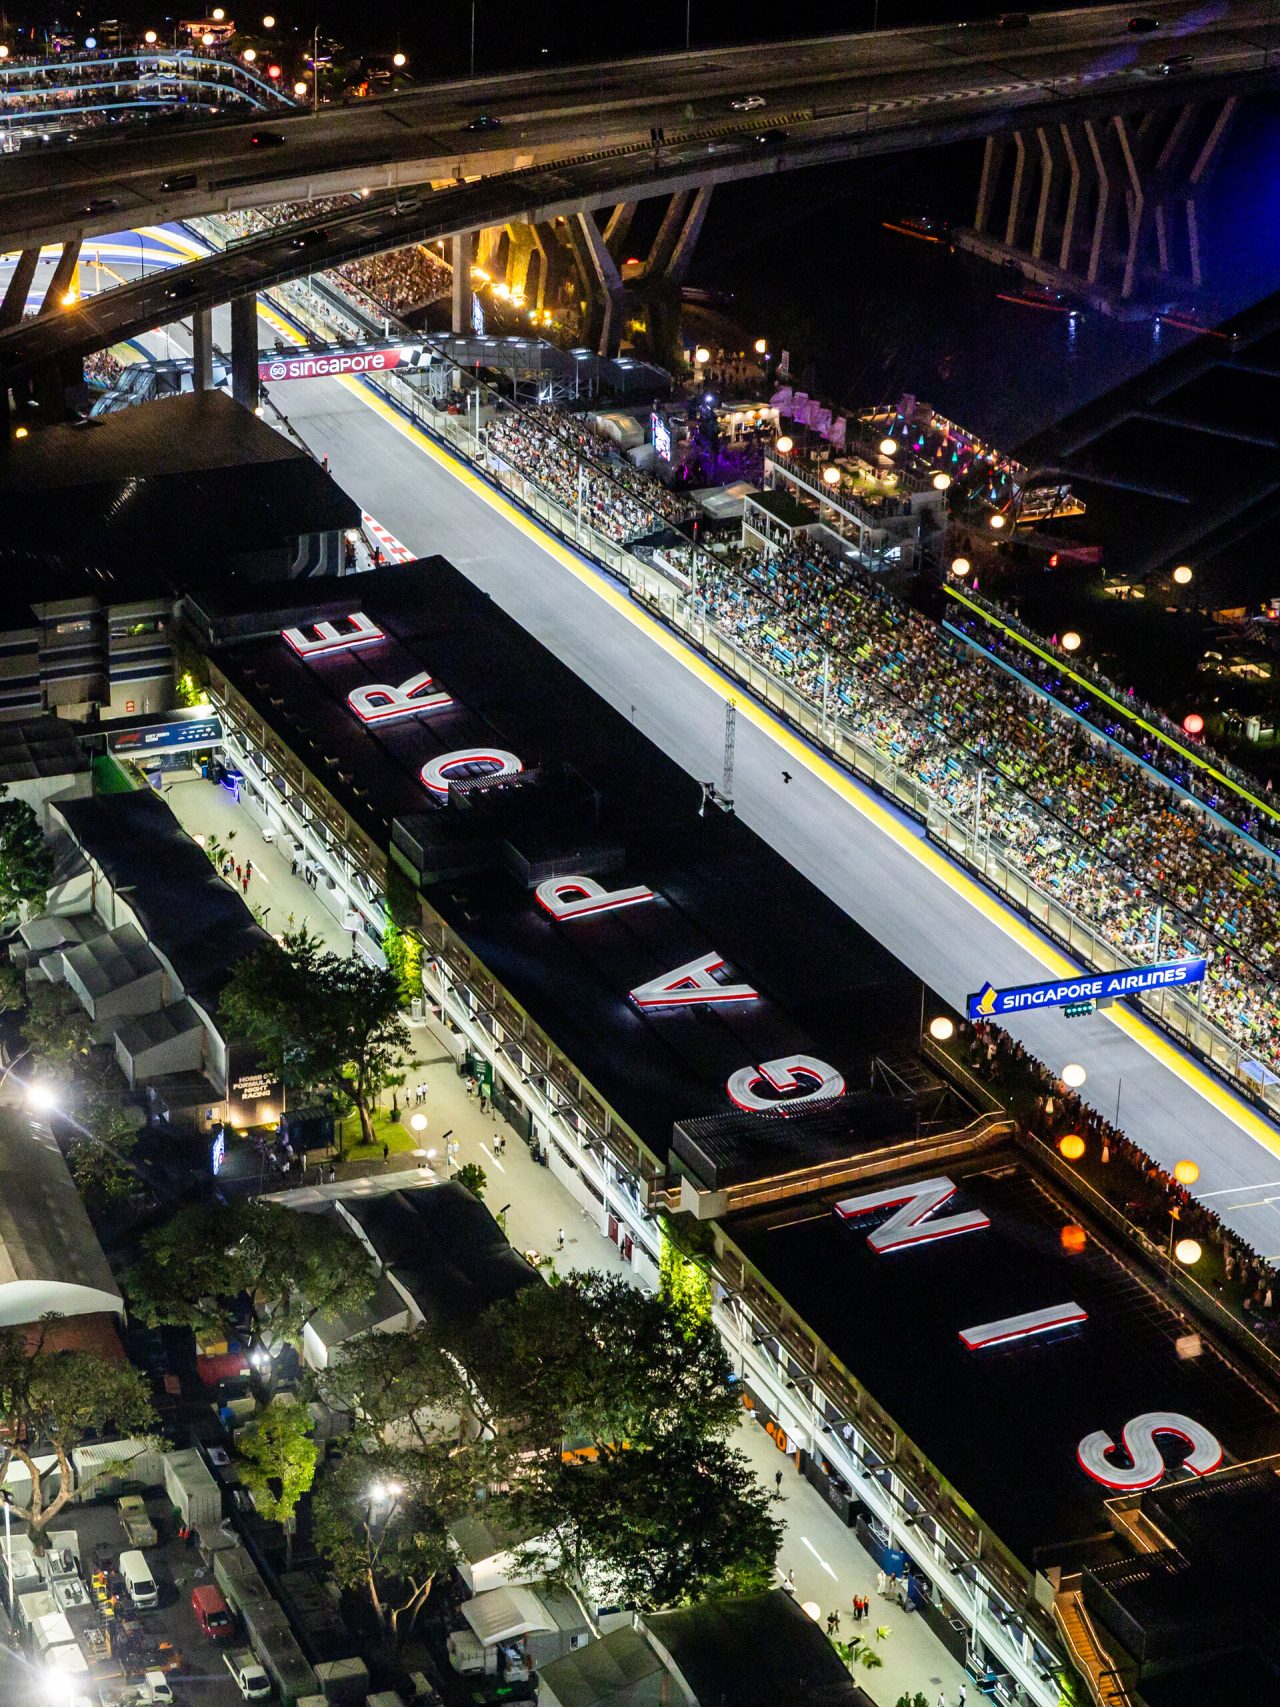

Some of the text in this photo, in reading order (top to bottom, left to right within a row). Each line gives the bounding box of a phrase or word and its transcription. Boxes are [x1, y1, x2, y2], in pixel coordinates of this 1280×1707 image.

[1003, 967, 1187, 1009] SINGAPORE AIRLINES
[238, 1074, 263, 1083] HOME
[1203, 1056, 1252, 1099] SINGAPORE AIRLINES
[243, 1085, 268, 1094] NIGHT
[242, 1090, 271, 1100] RACING
